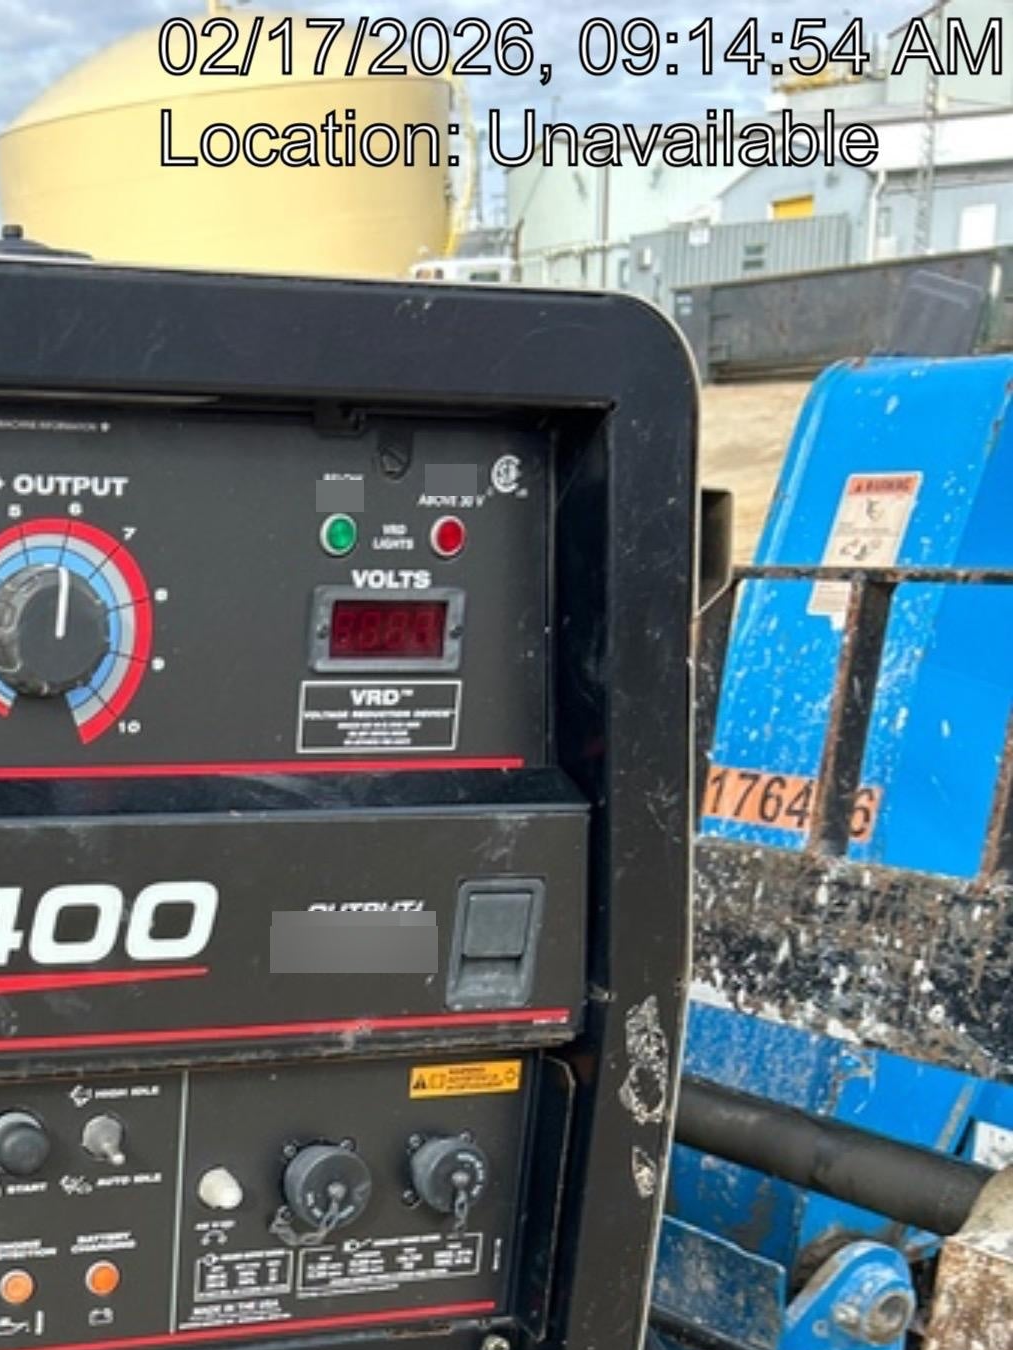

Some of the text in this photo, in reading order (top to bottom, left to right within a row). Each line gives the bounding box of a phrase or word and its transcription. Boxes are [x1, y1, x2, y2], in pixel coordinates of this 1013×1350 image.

[13, 474, 129, 496] OUTPUT
[68, 501, 83, 516] 6
[123, 526, 136, 540] 7
[351, 570, 432, 589] VOLTS
[118, 720, 141, 734] 10
[707, 770, 874, 838] 17646
